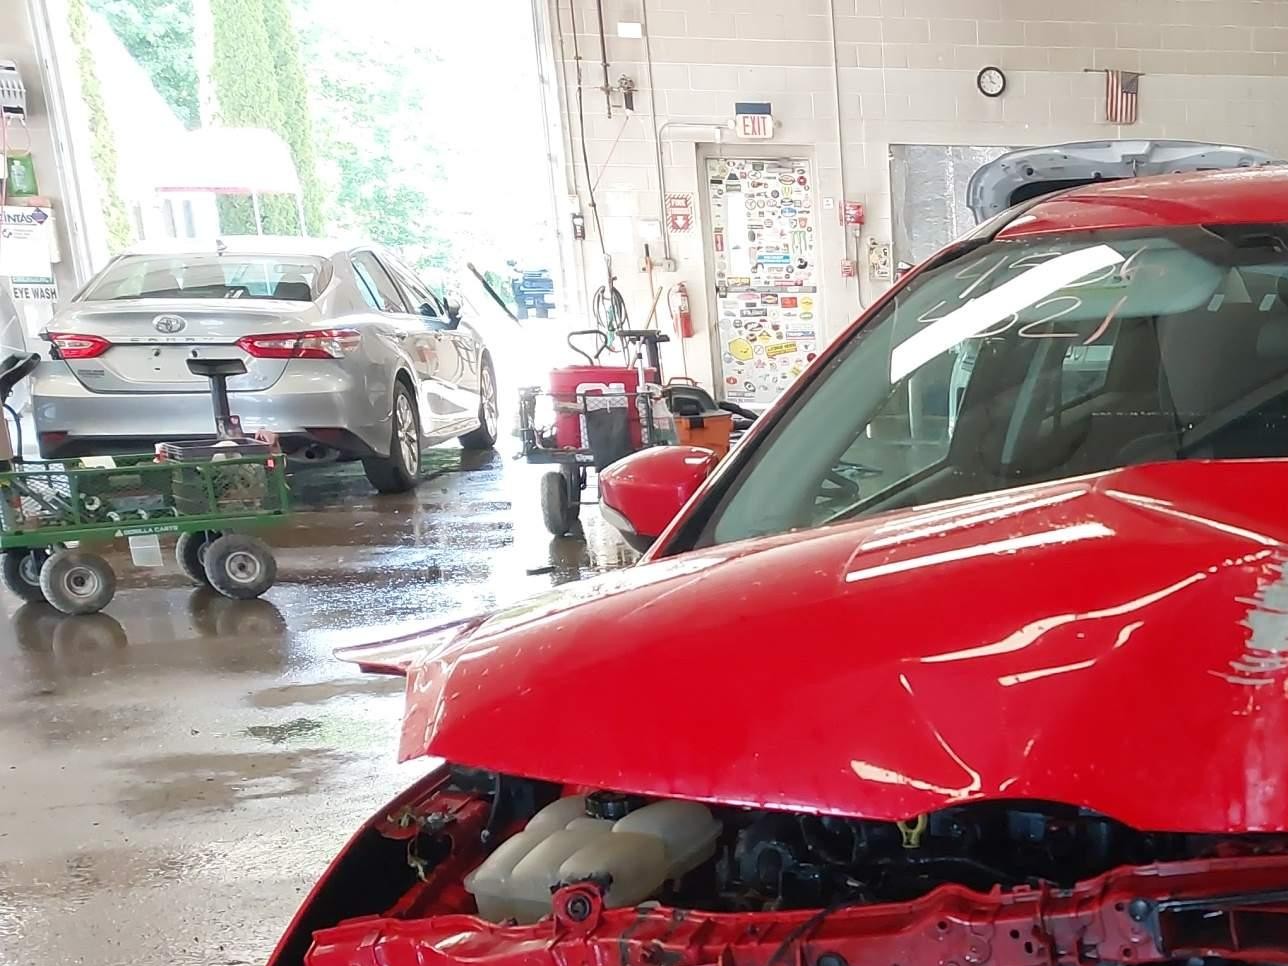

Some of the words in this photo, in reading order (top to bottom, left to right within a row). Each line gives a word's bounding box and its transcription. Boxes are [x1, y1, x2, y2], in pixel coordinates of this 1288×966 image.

[742, 115, 767, 136] EXIT
[0, 210, 33, 224] INTAS
[13, 287, 30, 299] EYE
[31, 287, 57, 300] WASH
